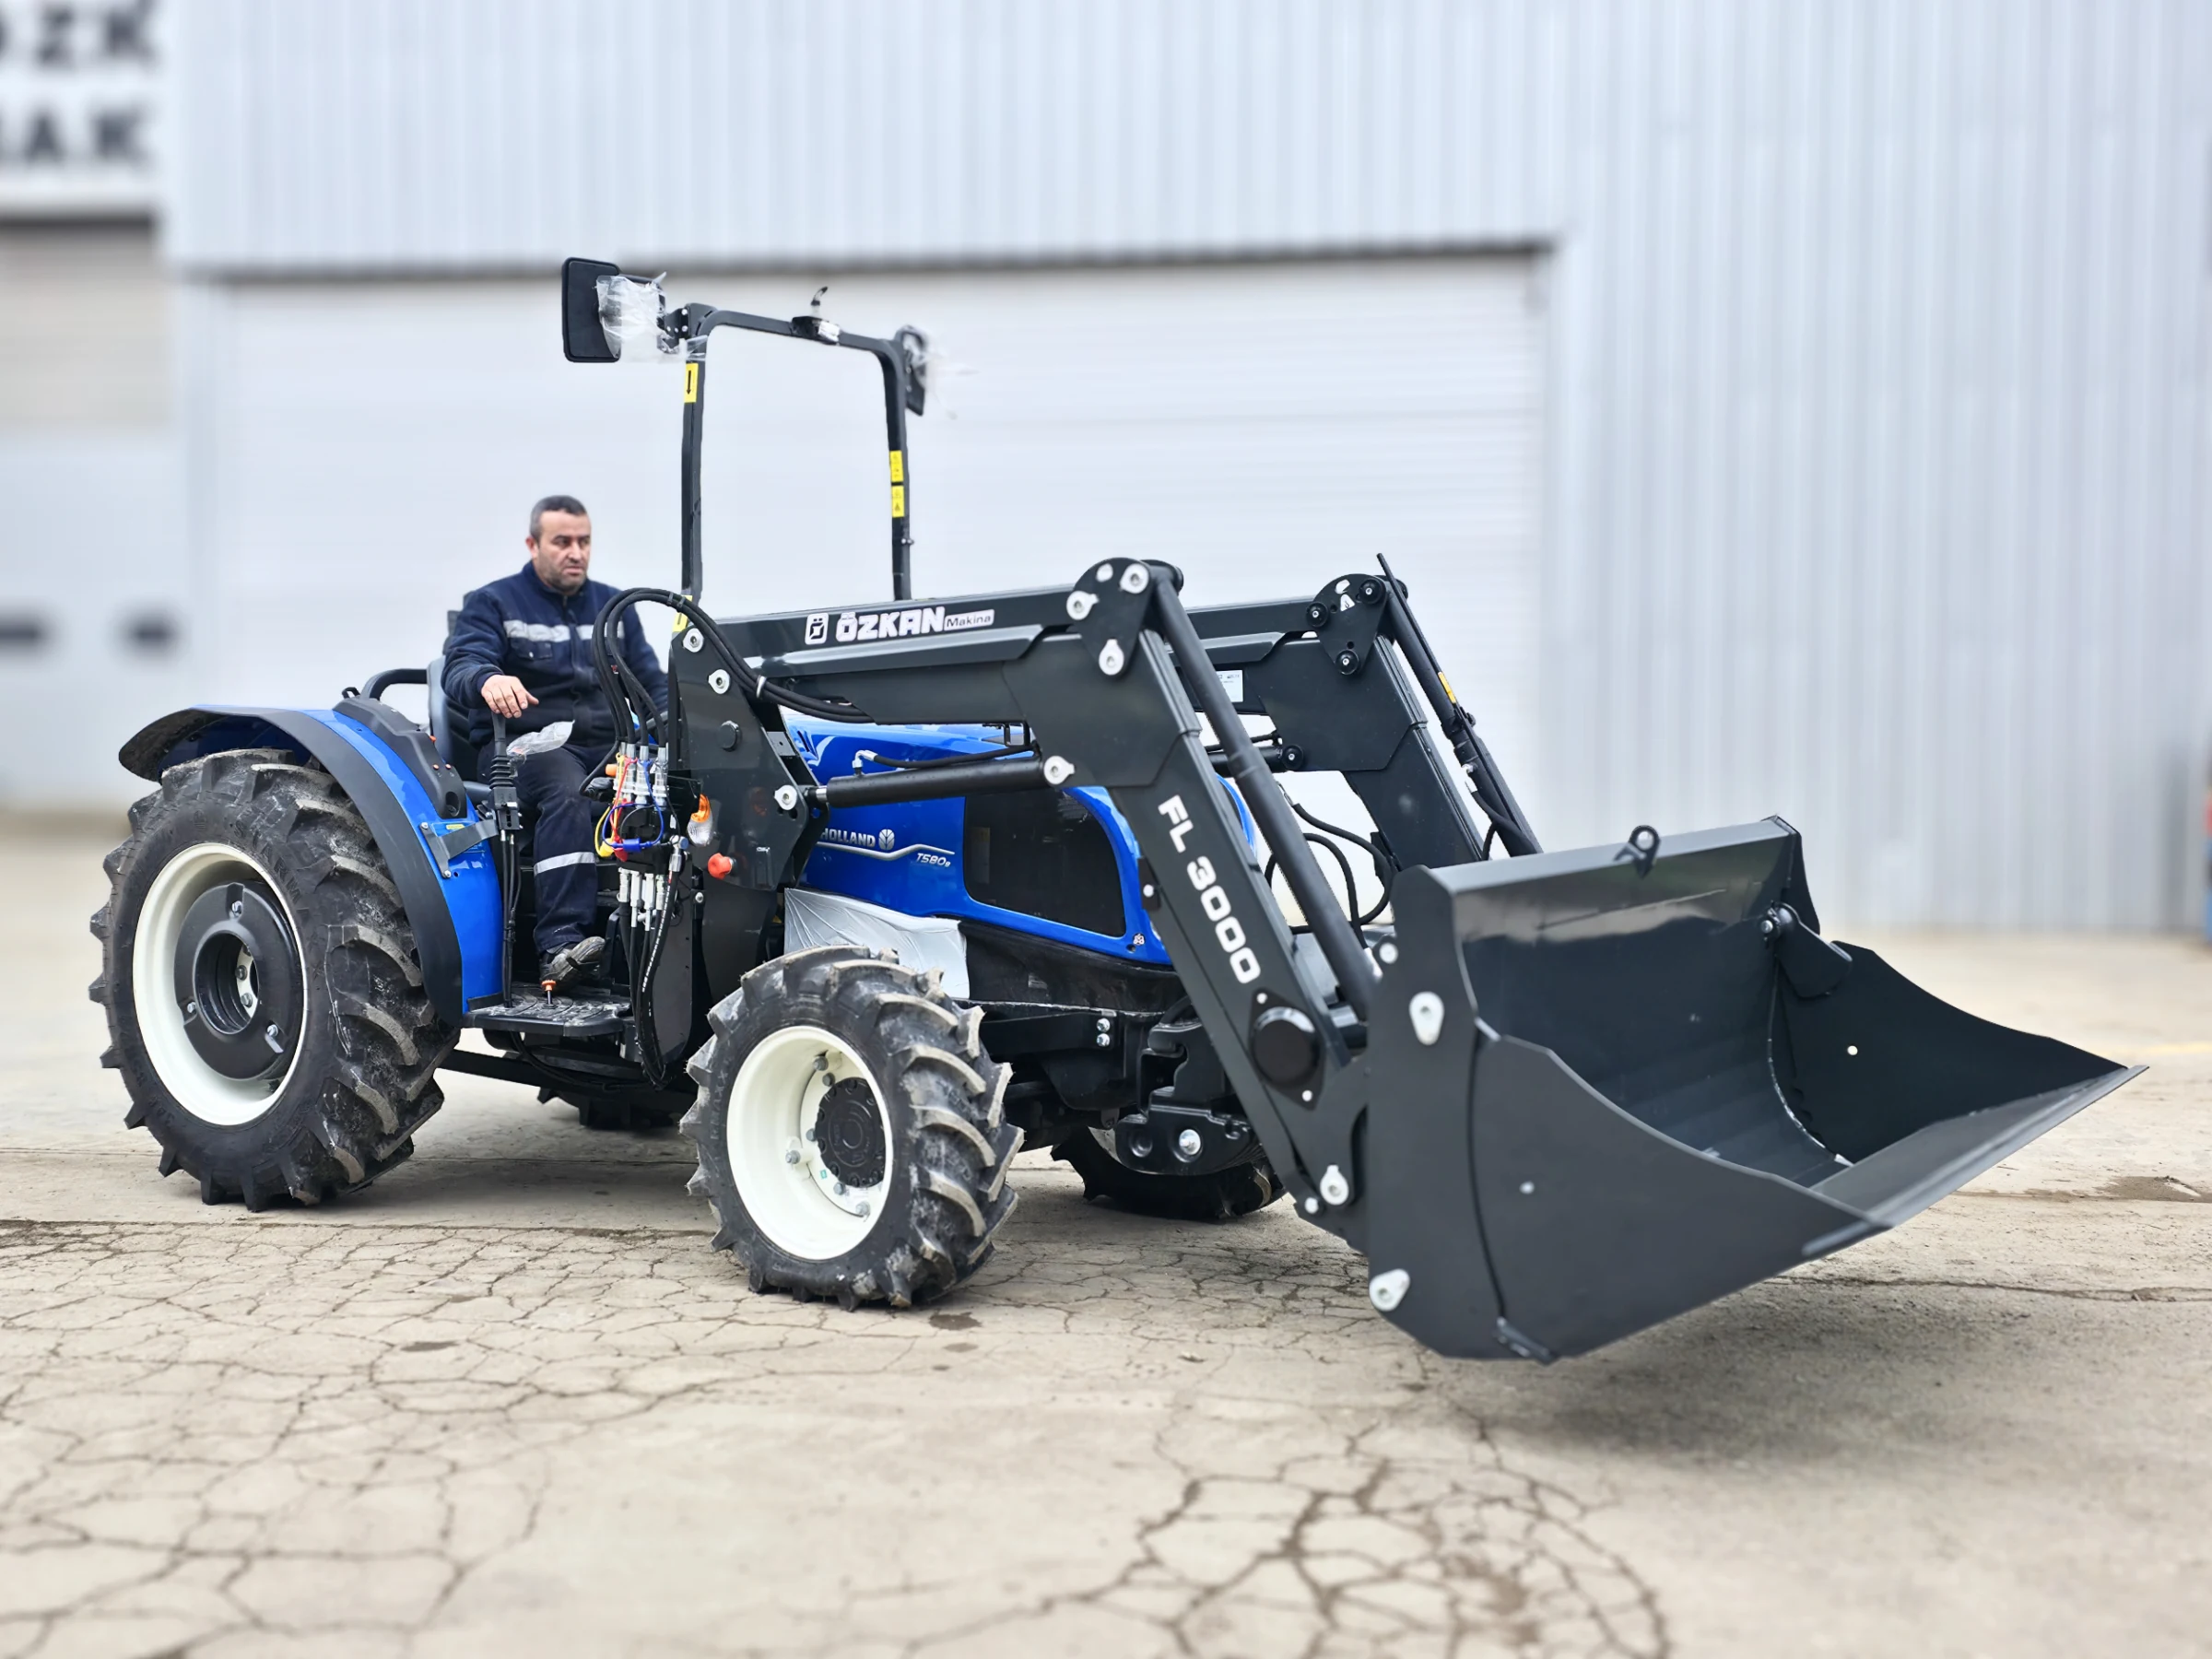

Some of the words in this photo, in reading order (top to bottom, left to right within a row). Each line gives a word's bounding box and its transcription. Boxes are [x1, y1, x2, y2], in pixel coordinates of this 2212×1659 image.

[835, 606, 946, 642] ÖZKAN
[947, 612, 993, 629] Makina
[820, 828, 876, 848] HOLLAND
[1158, 794, 1194, 853] FL
[1187, 855, 1261, 984] 3000
